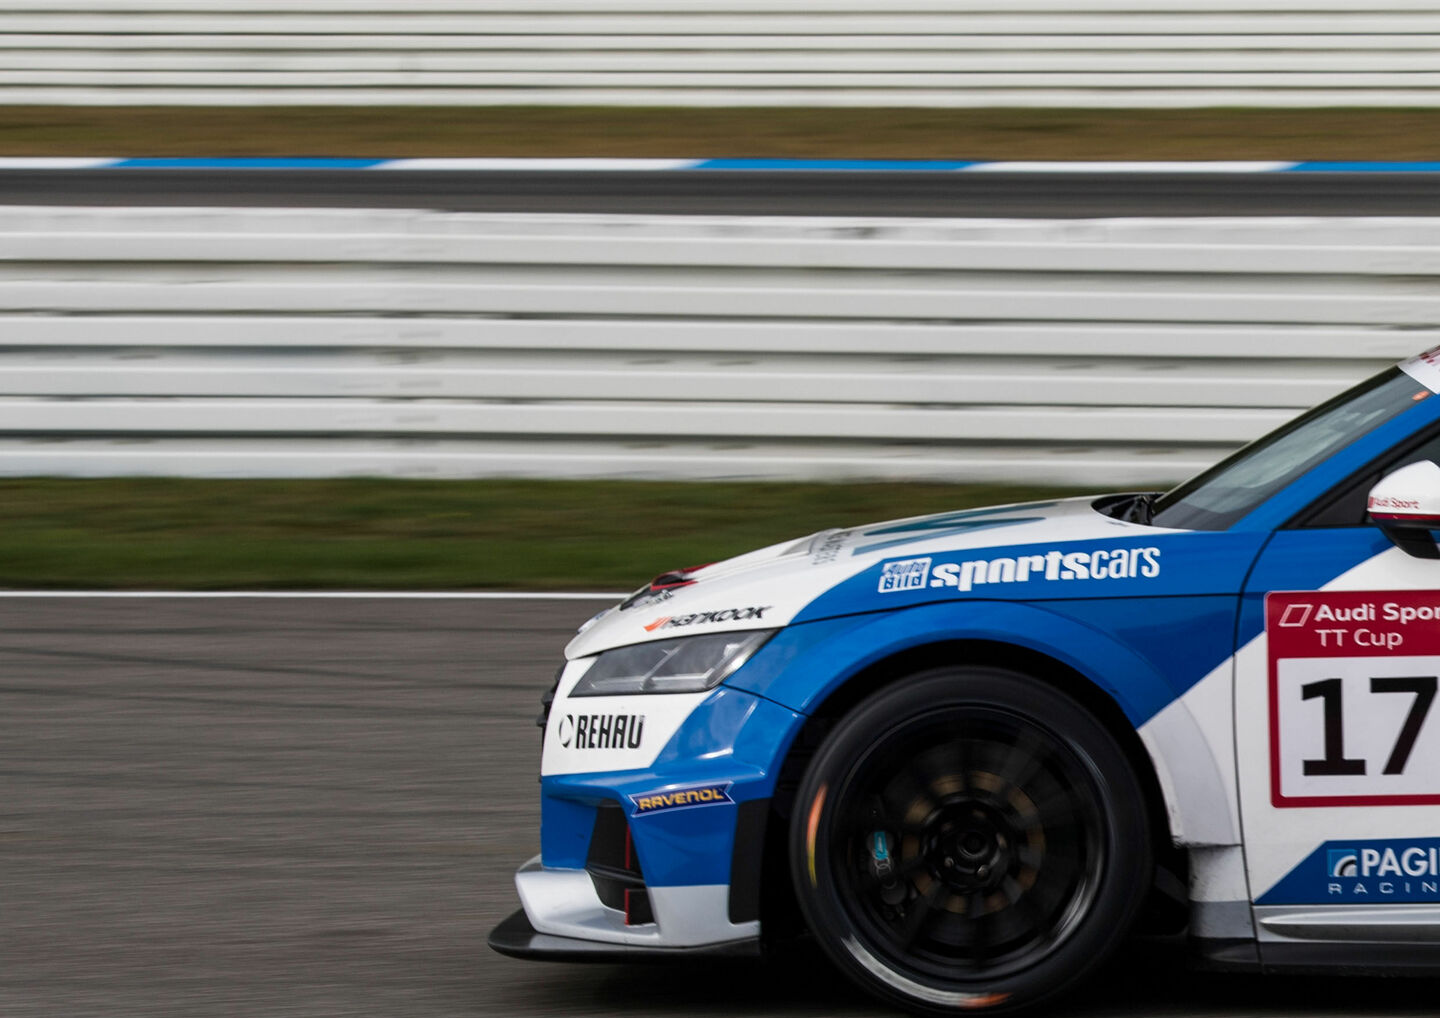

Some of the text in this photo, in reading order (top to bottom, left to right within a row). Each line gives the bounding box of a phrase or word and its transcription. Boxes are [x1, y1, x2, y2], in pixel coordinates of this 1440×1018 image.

[930, 547, 1160, 591] sportscars
[1314, 604, 1375, 622] Audi
[1314, 628, 1403, 650] TT Cup
[575, 714, 645, 750] REHAU
[1301, 676, 1439, 777] 17
